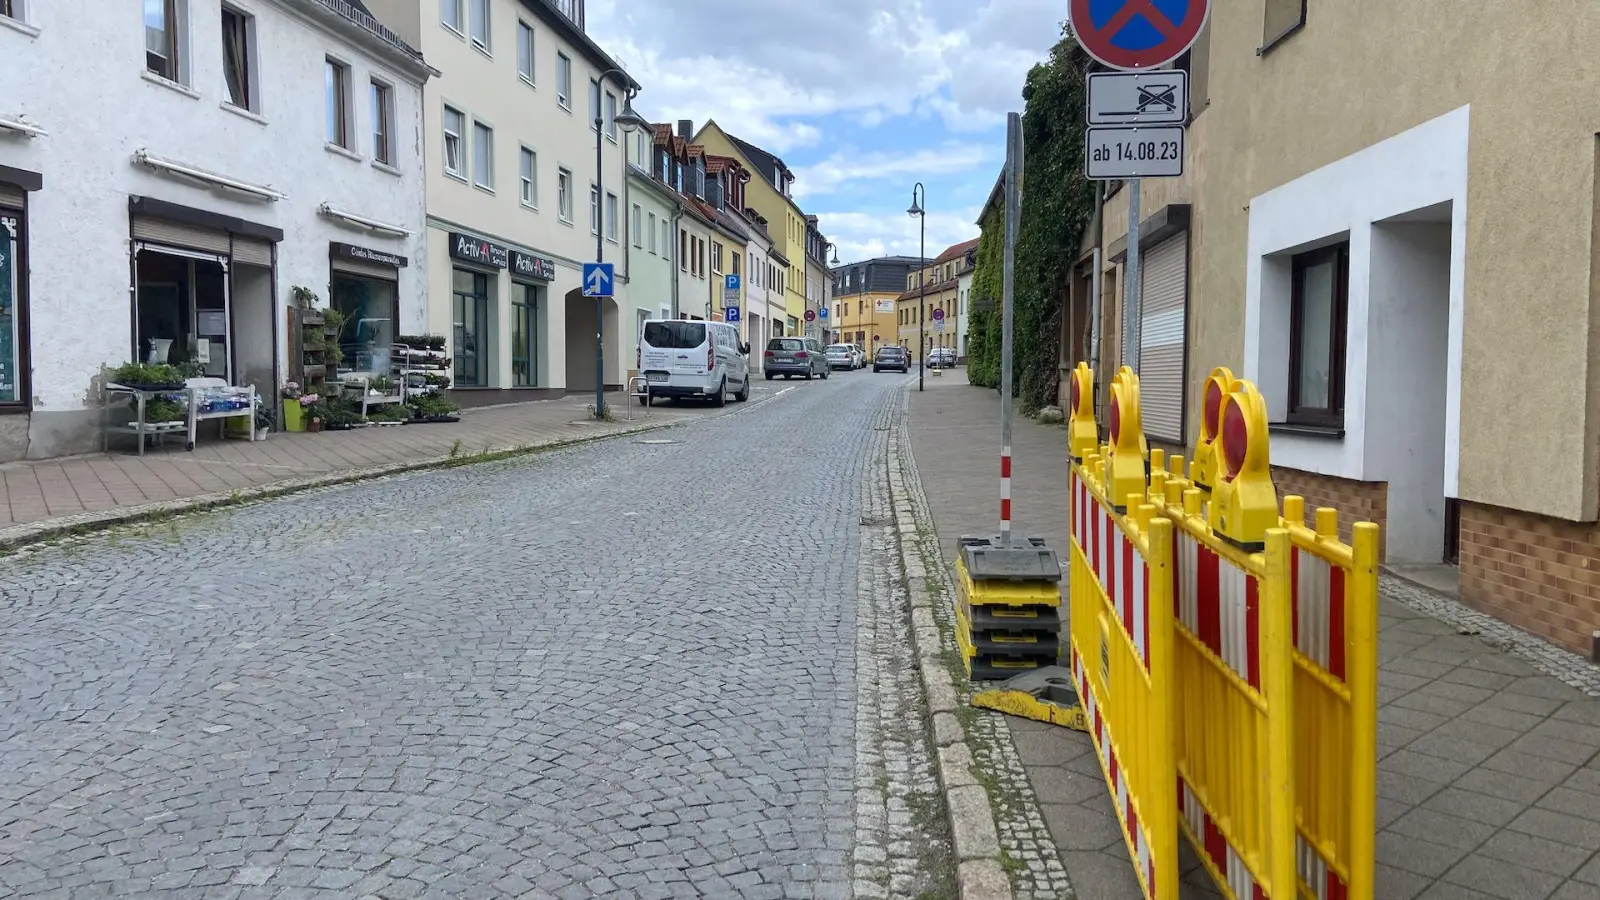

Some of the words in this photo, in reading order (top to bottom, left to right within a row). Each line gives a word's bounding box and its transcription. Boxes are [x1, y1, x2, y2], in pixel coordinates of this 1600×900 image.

[1093, 144, 1110, 161] ab
[1116, 142, 1178, 161] 14.08.23
[728, 276, 737, 288] P
[729, 308, 737, 320] P
